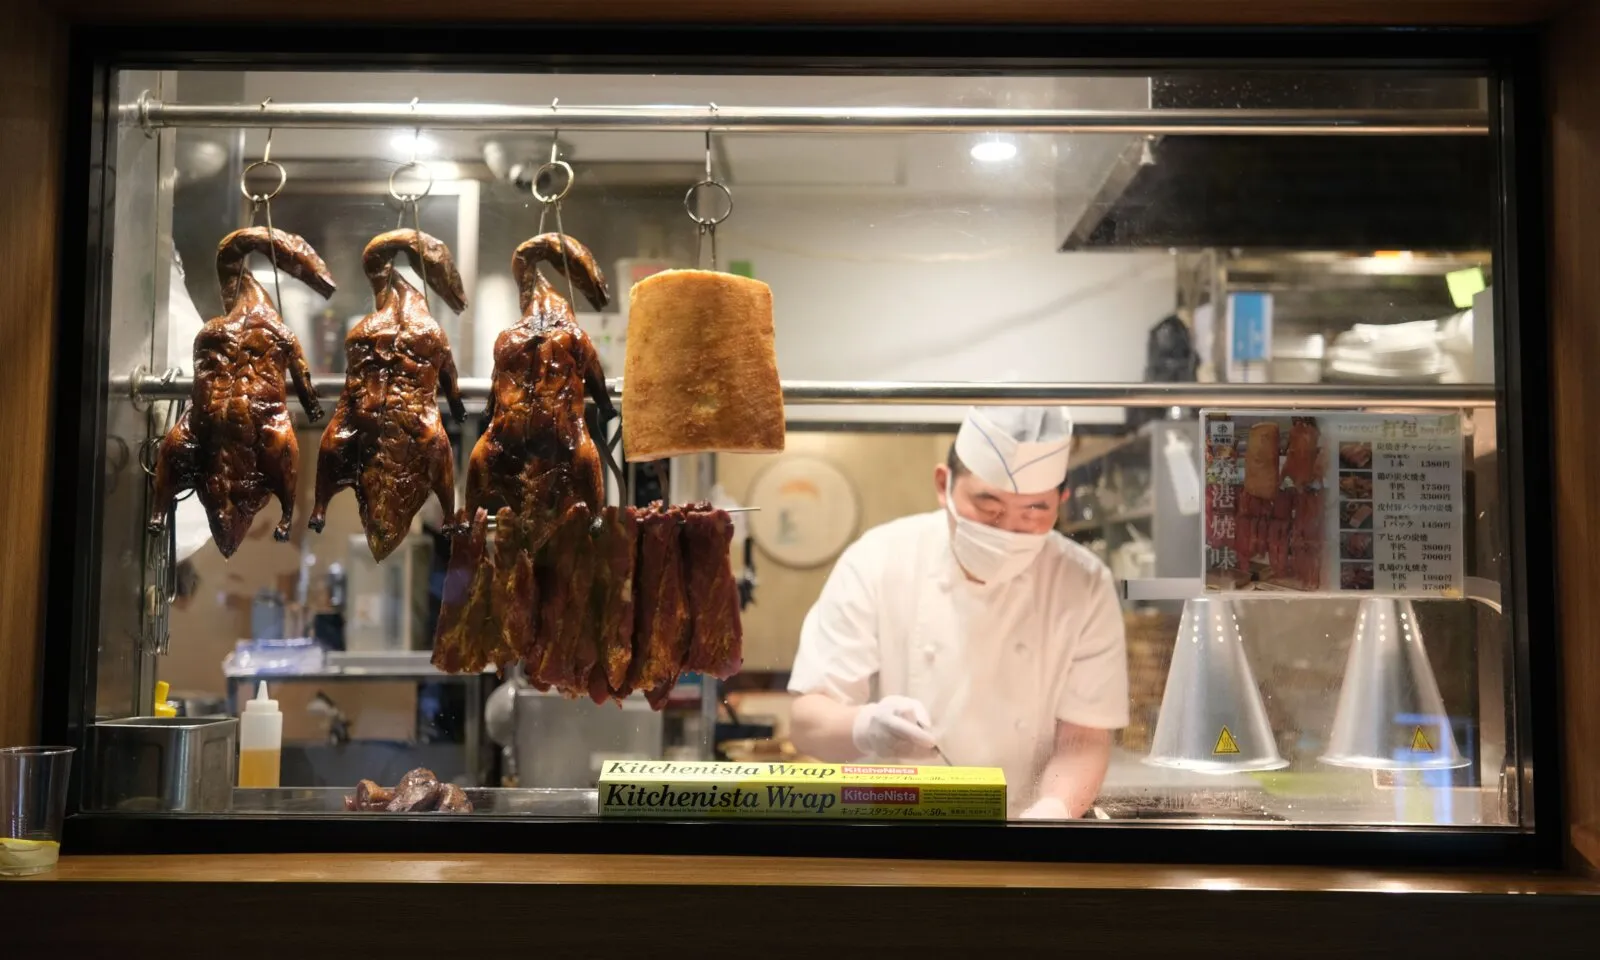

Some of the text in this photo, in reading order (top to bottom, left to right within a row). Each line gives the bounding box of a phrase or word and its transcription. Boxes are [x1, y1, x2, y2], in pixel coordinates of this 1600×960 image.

[607, 762, 836, 778] Kitchenista Wrap
[604, 783, 836, 813] Kitchenista Wrap
[844, 790, 916, 801] KitcheNista
[840, 808, 902, 816] キッチニスタラップ
